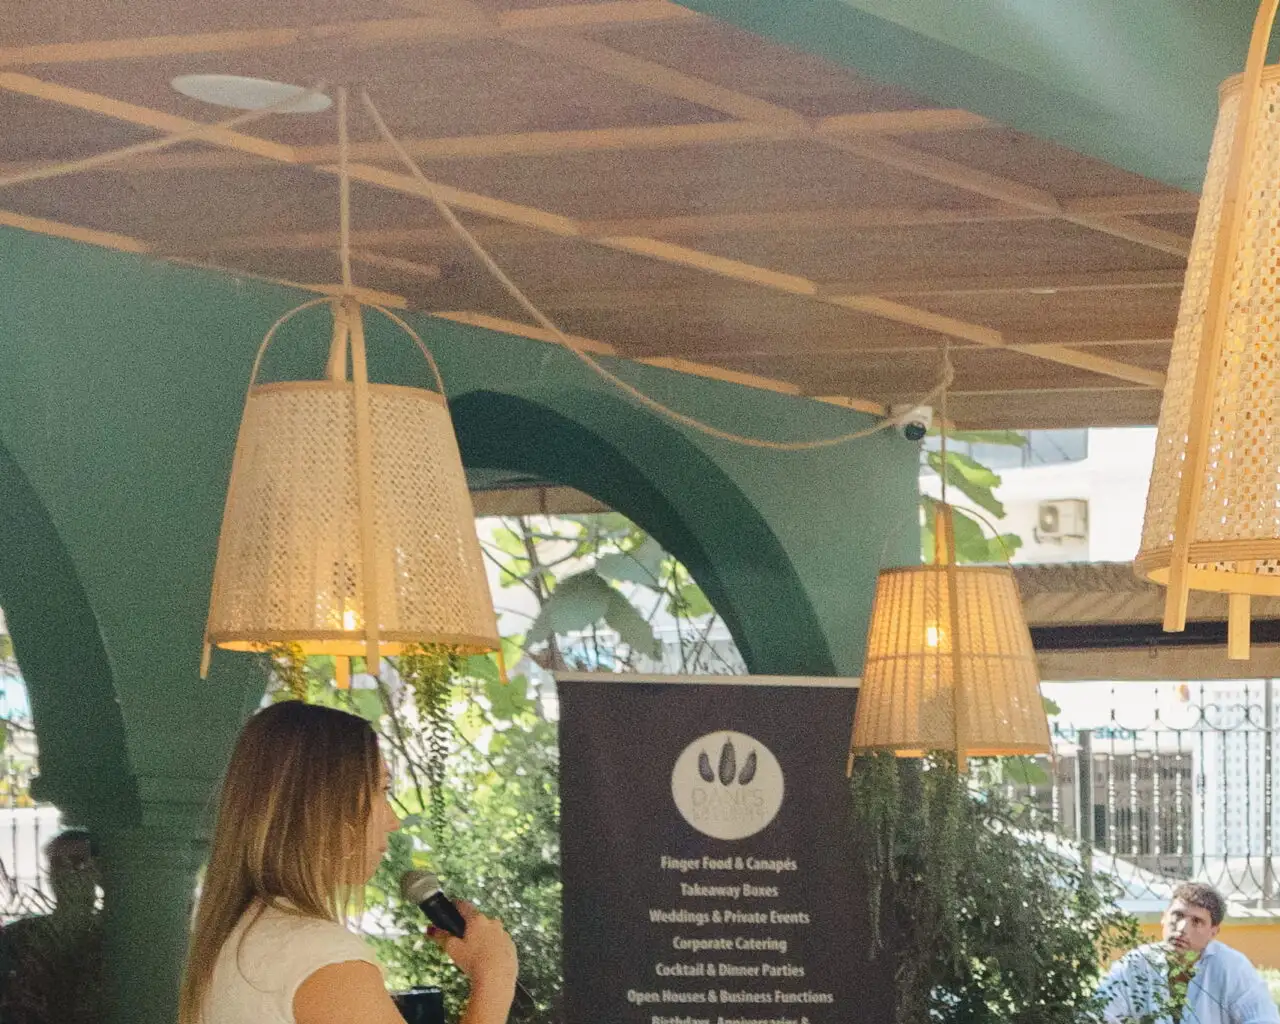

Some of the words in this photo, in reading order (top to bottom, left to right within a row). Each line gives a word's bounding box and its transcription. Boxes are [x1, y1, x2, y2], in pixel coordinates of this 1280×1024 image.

[660, 855, 700, 873] Finger
[702, 855, 733, 870] Food
[734, 856, 744, 871] &
[680, 882, 741, 900] Takeaway
[742, 883, 779, 898] Boxes
[648, 908, 710, 927] Weddings
[711, 909, 722, 924] &
[723, 909, 768, 924] Private
[769, 909, 811, 924] Events
[672, 935, 734, 953] Corporate
[734, 936, 788, 954] Catering
[655, 962, 705, 977] Cocktail
[706, 962, 717, 977] &
[718, 962, 760, 977] Dinner
[761, 962, 805, 977] Parties
[627, 989, 660, 1006] Open
[662, 989, 706, 1003] Houses
[707, 989, 718, 1003] &
[719, 989, 772, 1004] Business
[774, 989, 834, 1004] Functions
